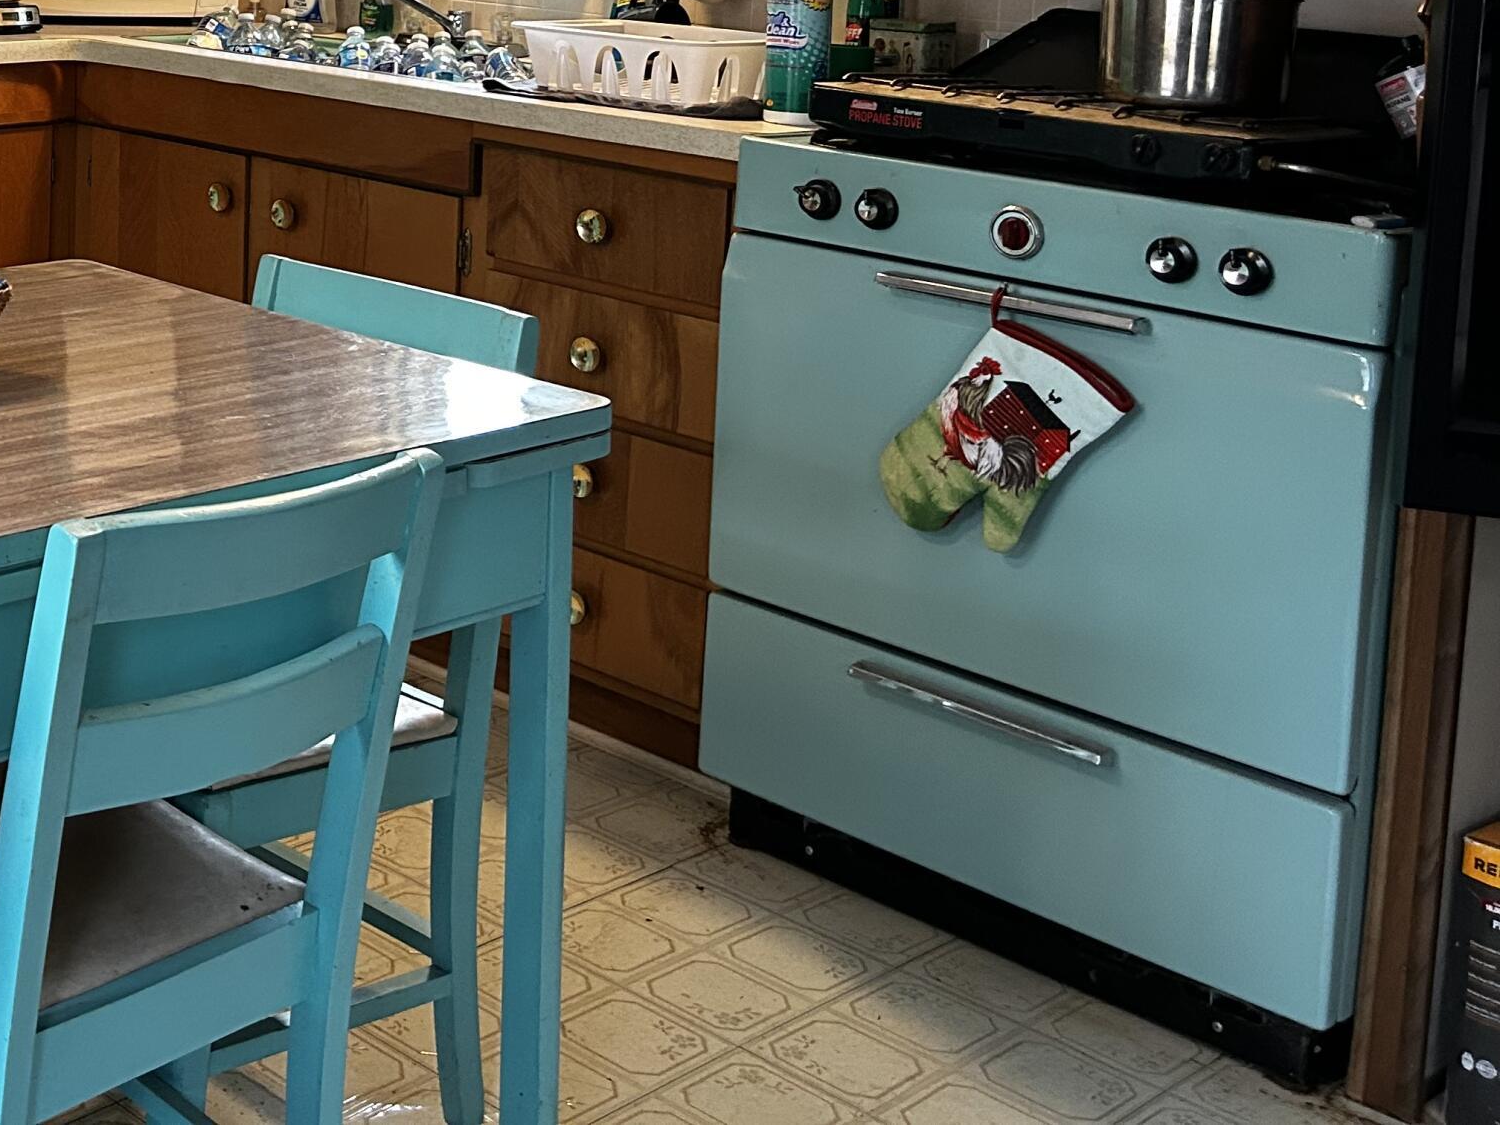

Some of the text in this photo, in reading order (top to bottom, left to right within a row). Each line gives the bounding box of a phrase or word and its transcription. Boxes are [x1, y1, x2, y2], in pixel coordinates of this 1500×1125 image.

[848, 109, 924, 129] PROPANE STOVE
[1474, 856, 1500, 878] RE
